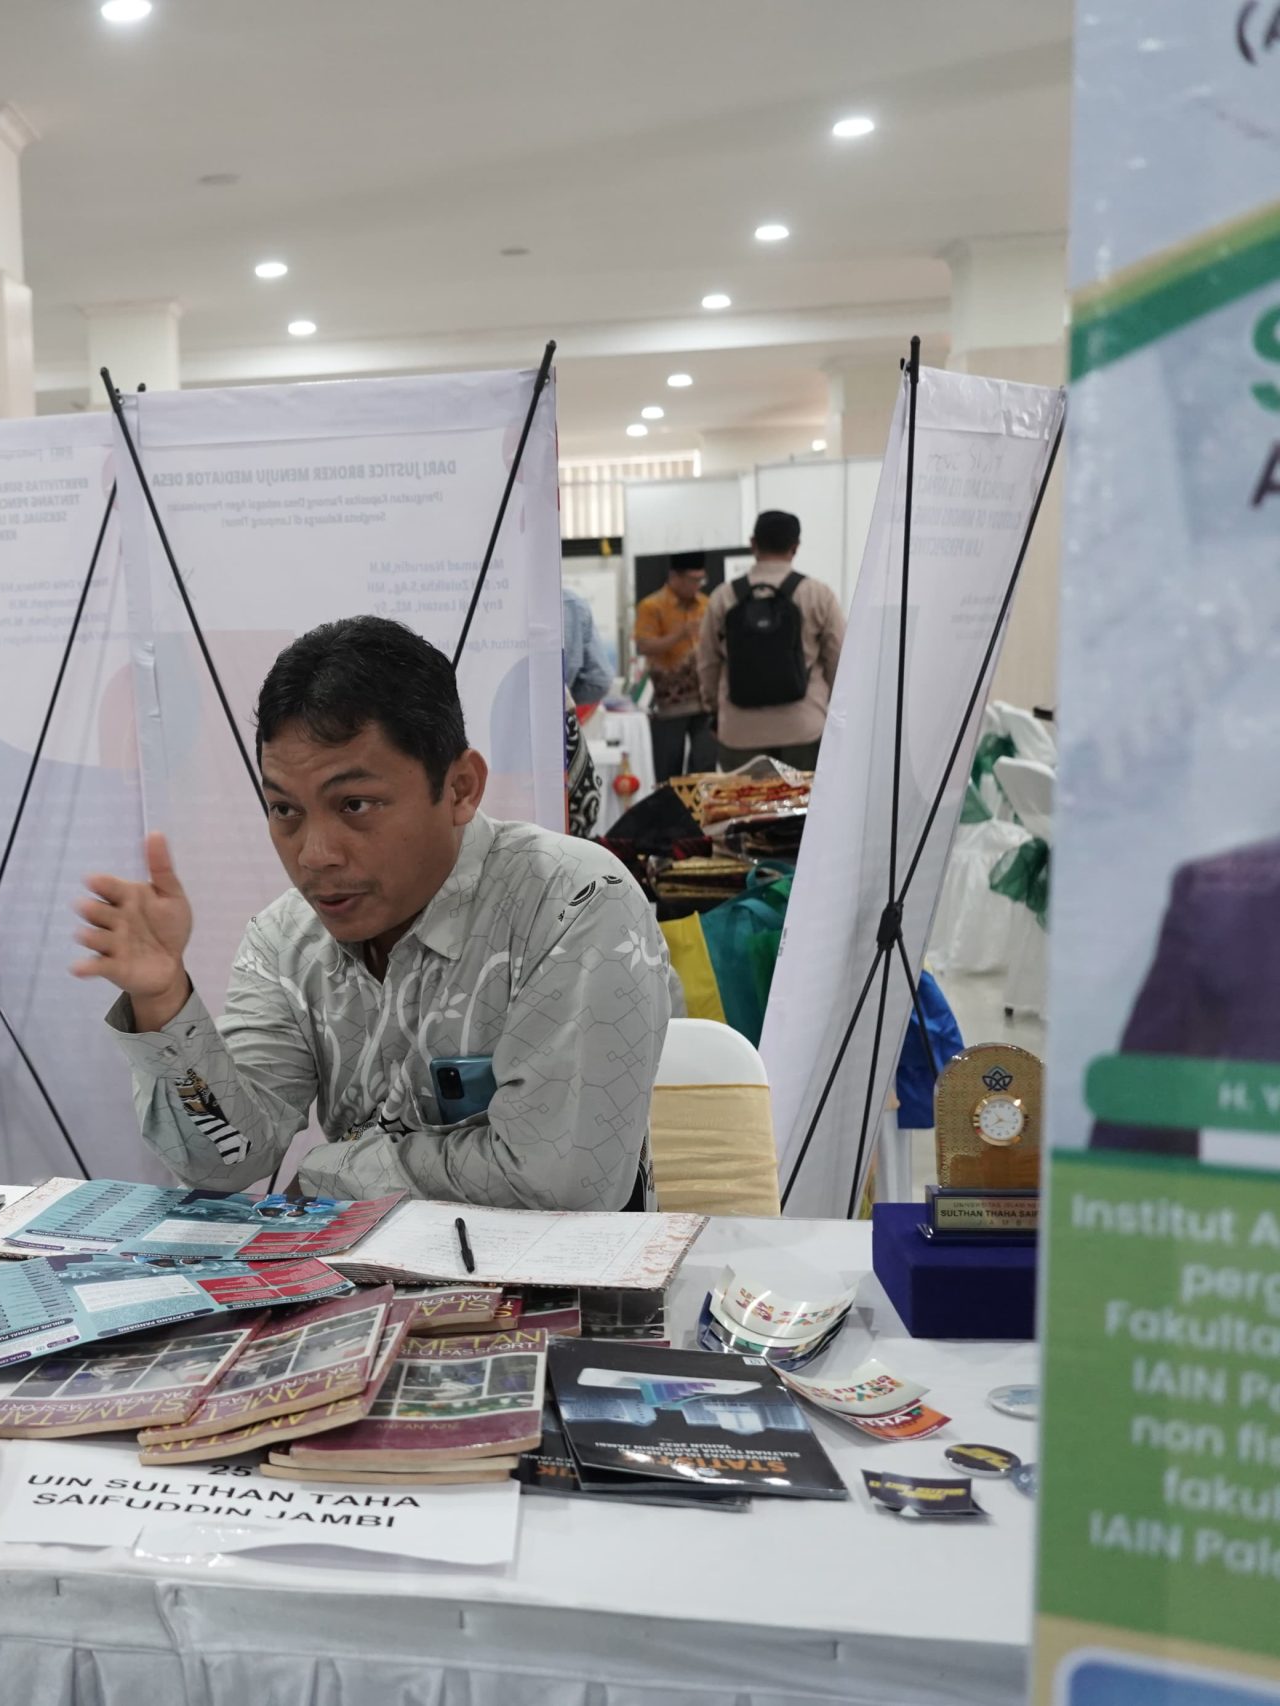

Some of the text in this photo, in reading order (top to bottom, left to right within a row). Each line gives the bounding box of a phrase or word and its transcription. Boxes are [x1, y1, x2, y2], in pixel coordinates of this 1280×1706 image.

[940, 1209, 983, 1217] SULTHAN
[985, 1209, 1017, 1217] THAHA
[1070, 1192, 1236, 1247] Institut
[9, 1326, 40, 1338] JOURNAL
[40, 1320, 66, 1330] ONLINE
[439, 1342, 535, 1357] PASSPORT
[1129, 1354, 1228, 1408] IAIN
[1128, 1412, 1227, 1458] non
[208, 1463, 253, 1478] 25
[27, 1474, 422, 1508] UIN SULTHAN TAHA
[32, 1493, 397, 1528] SAIFUDDIN JAMBI
[1086, 1509, 1183, 1564] IAIN
